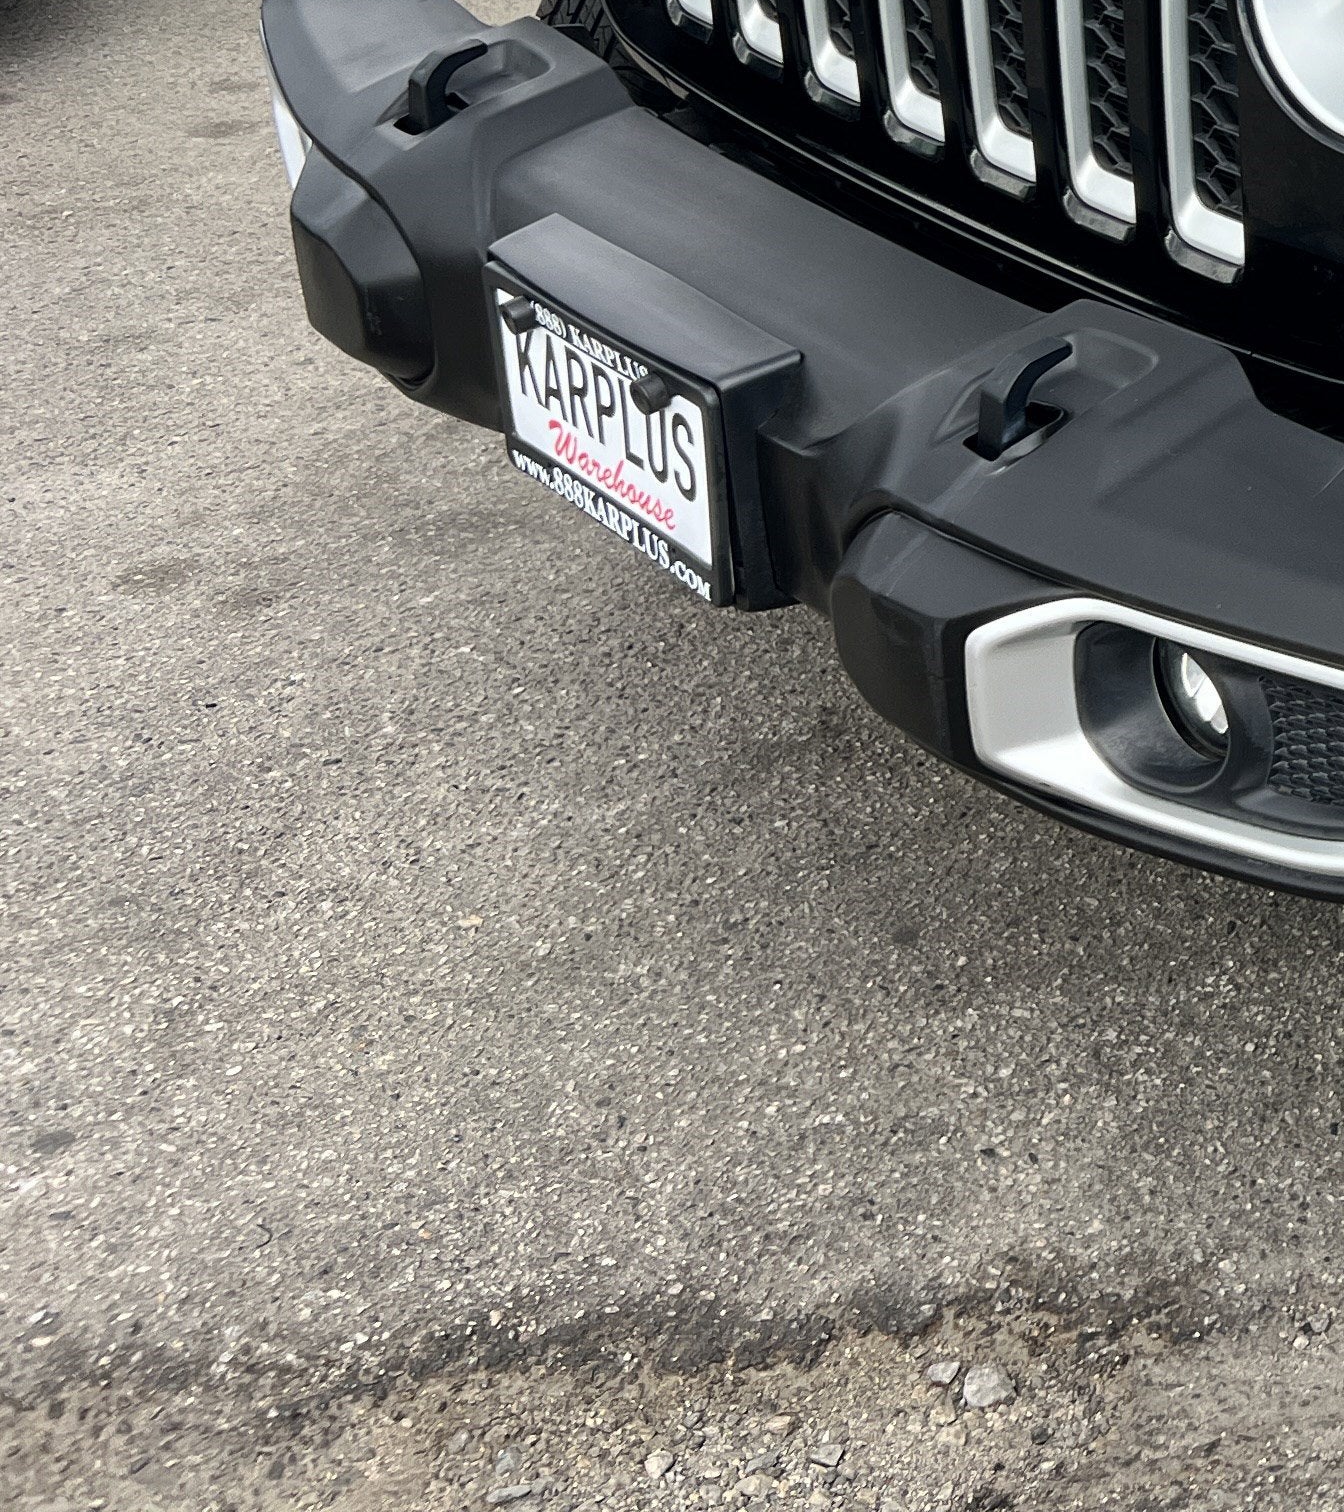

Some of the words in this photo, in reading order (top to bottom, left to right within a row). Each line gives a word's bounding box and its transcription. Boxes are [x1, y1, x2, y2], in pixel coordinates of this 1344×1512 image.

[530, 300, 567, 339] 888)
[515, 330, 697, 503] KARPLUS
[548, 419, 676, 530] Warehouse
